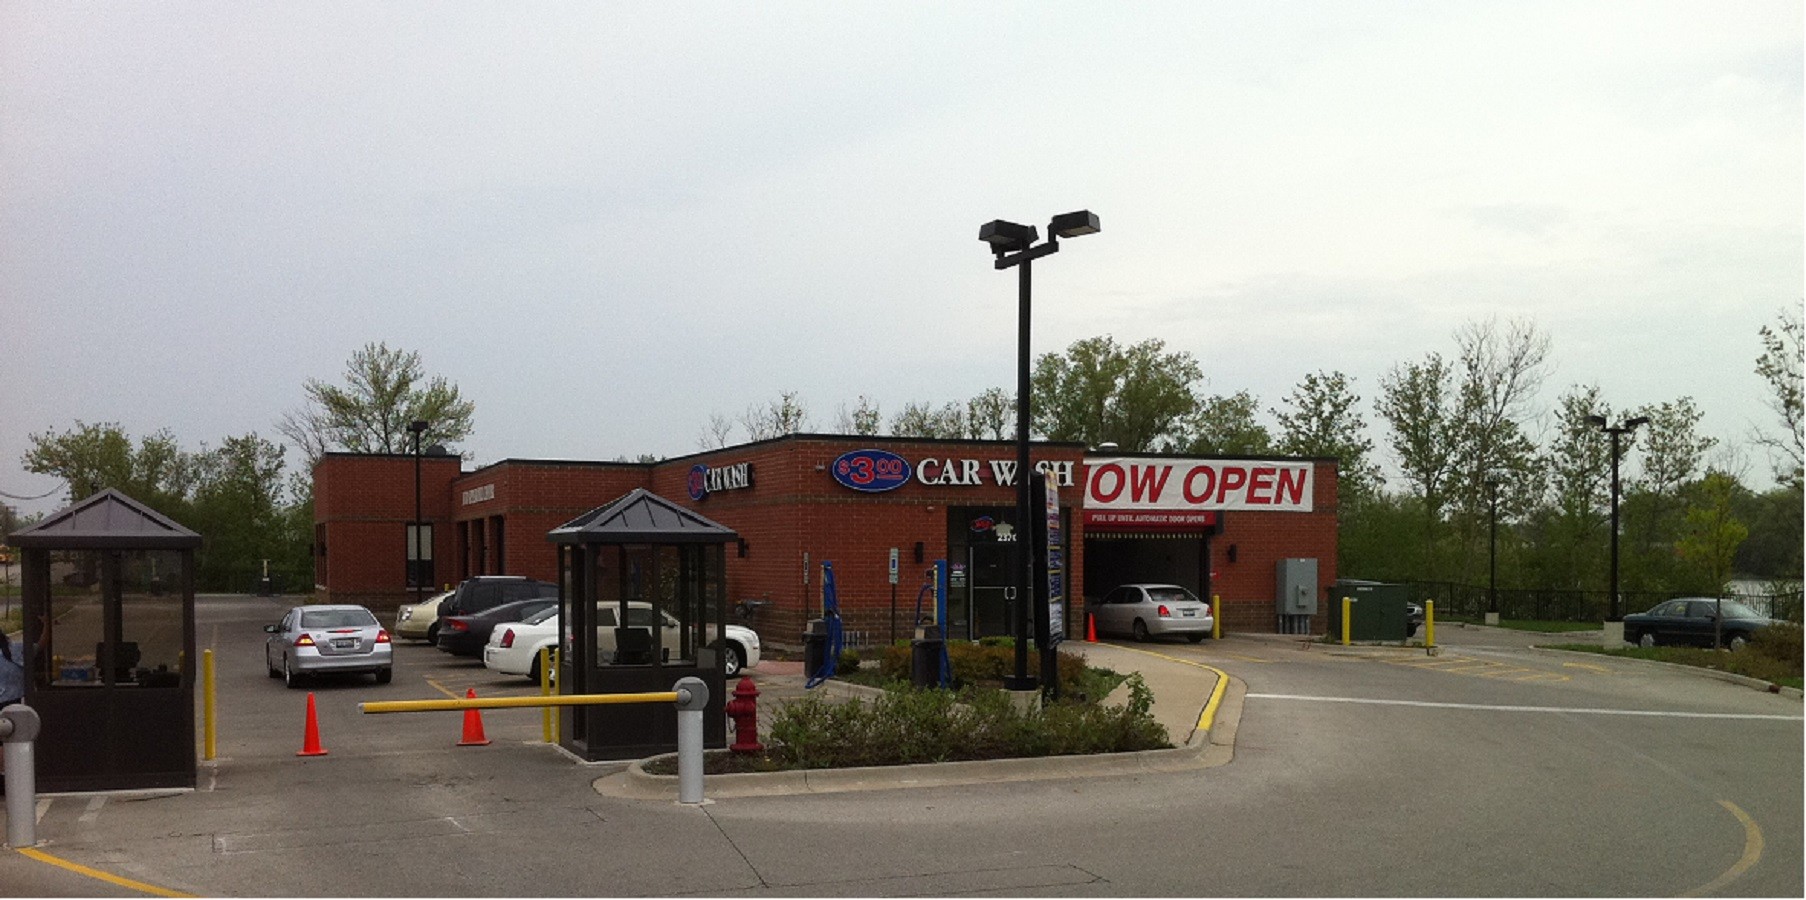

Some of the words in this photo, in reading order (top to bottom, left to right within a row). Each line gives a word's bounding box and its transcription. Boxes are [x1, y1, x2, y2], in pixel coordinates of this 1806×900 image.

[703, 467, 722, 492] CAR
[722, 462, 749, 490] WASH
[916, 458, 982, 486] CAR
[989, 459, 1075, 487] WSH
[1182, 465, 1307, 505] OPEN
[1091, 514, 1107, 522] PULL
[1107, 514, 1117, 522] UP
[1117, 514, 1134, 522] UNTIL
[1135, 514, 1168, 523] AUTOMATIC
[1168, 515, 1185, 523] DOOR
